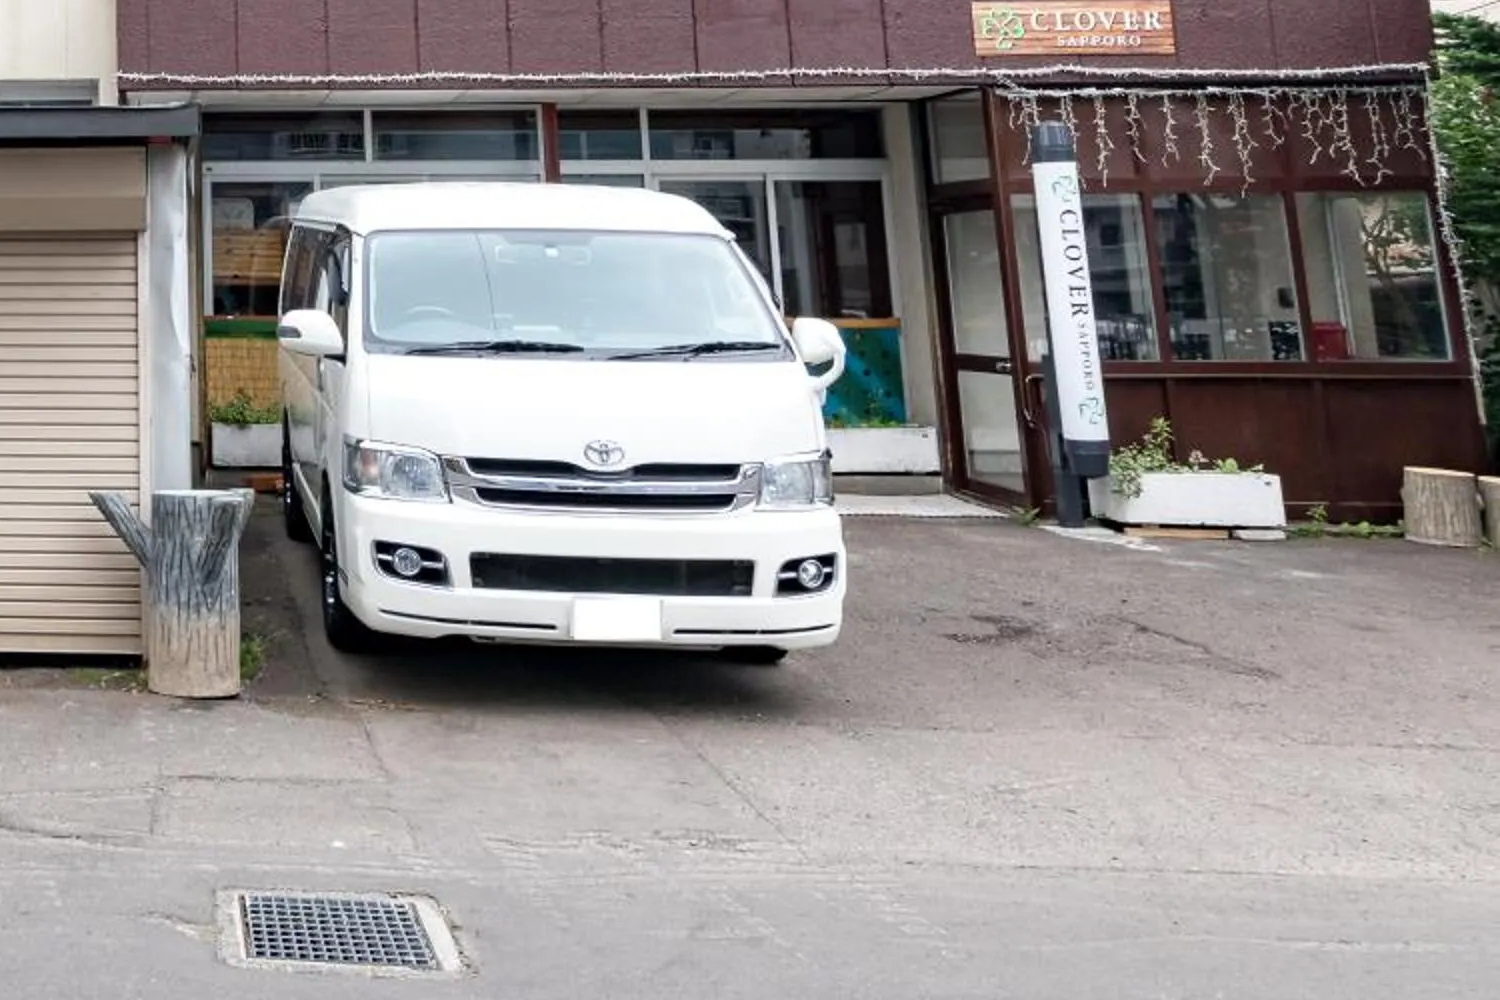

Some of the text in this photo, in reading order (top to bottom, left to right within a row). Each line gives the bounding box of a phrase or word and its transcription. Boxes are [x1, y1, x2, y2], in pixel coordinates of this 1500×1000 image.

[1030, 9, 1162, 31] CLOVER
[1056, 34, 1141, 47] SAPPORO
[1059, 208, 1094, 391] CLOVER SAPPORO
